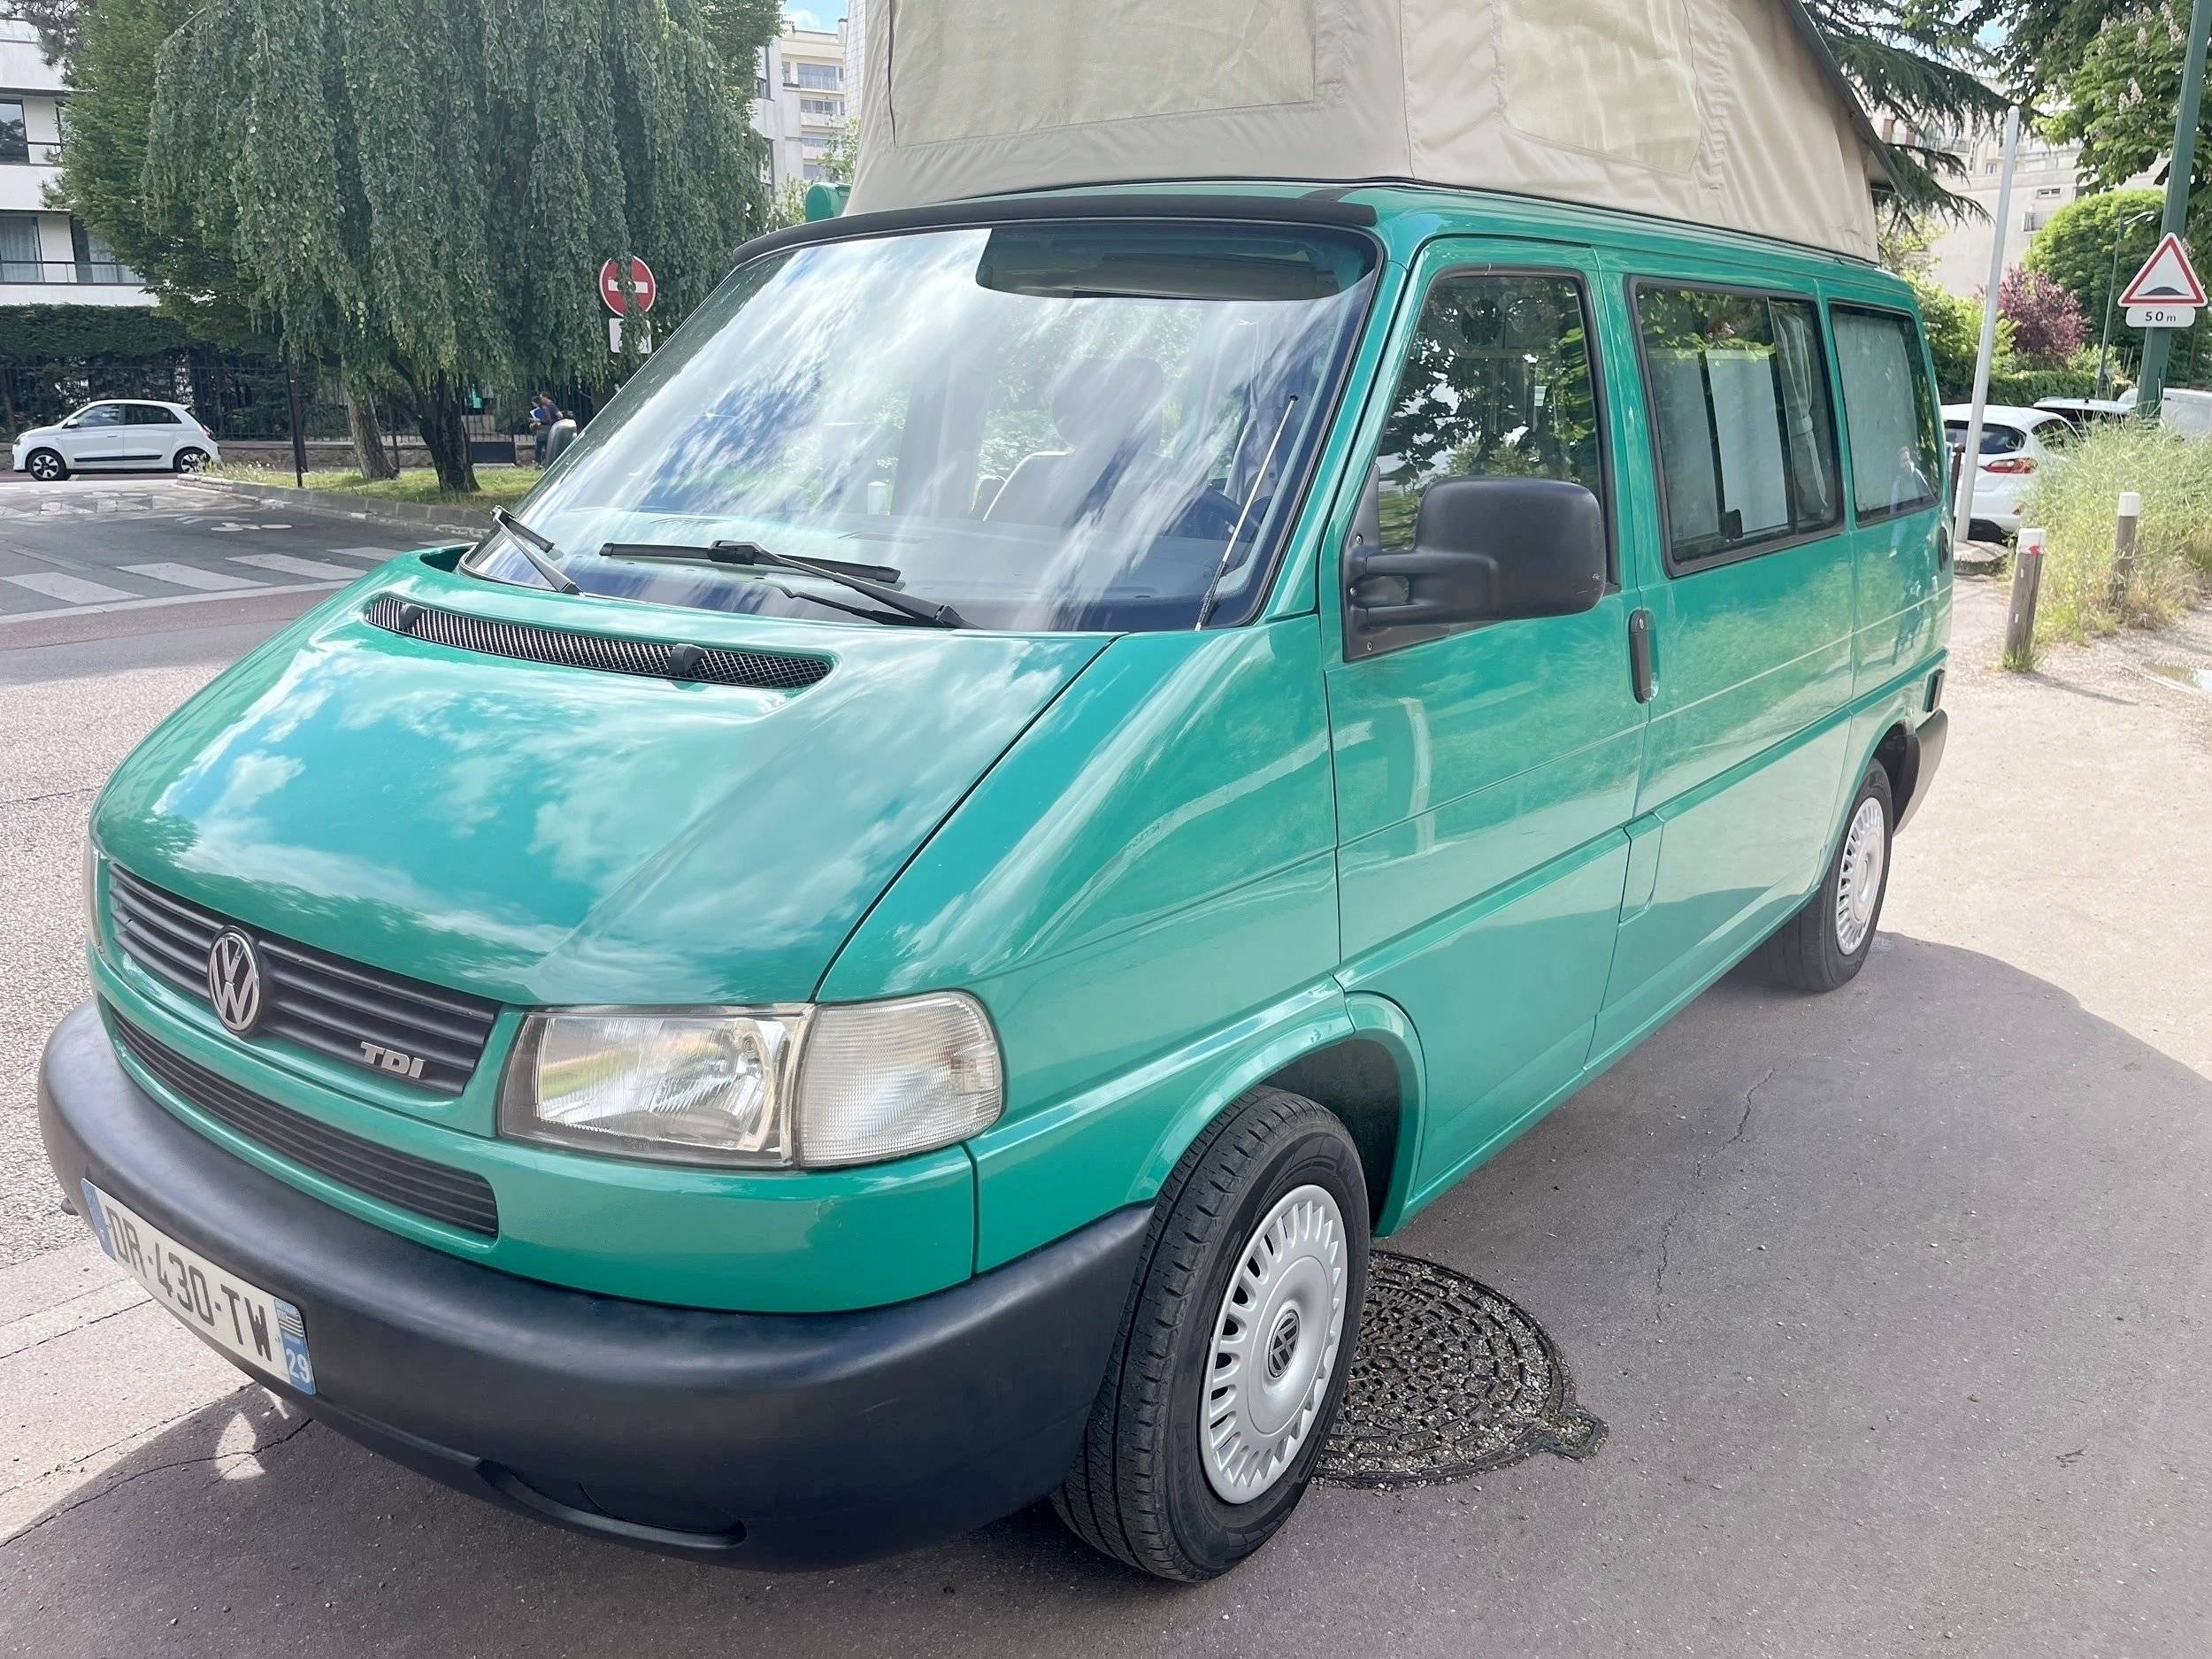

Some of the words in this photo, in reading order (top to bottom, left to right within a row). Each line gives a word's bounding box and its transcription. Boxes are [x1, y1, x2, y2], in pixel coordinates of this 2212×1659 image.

[2146, 311, 2163, 321] 50
[210, 932, 260, 1031] VW
[361, 1041, 426, 1079] TDI
[105, 1205, 273, 1362] DR-430-TW
[286, 1348, 311, 1383] 29
